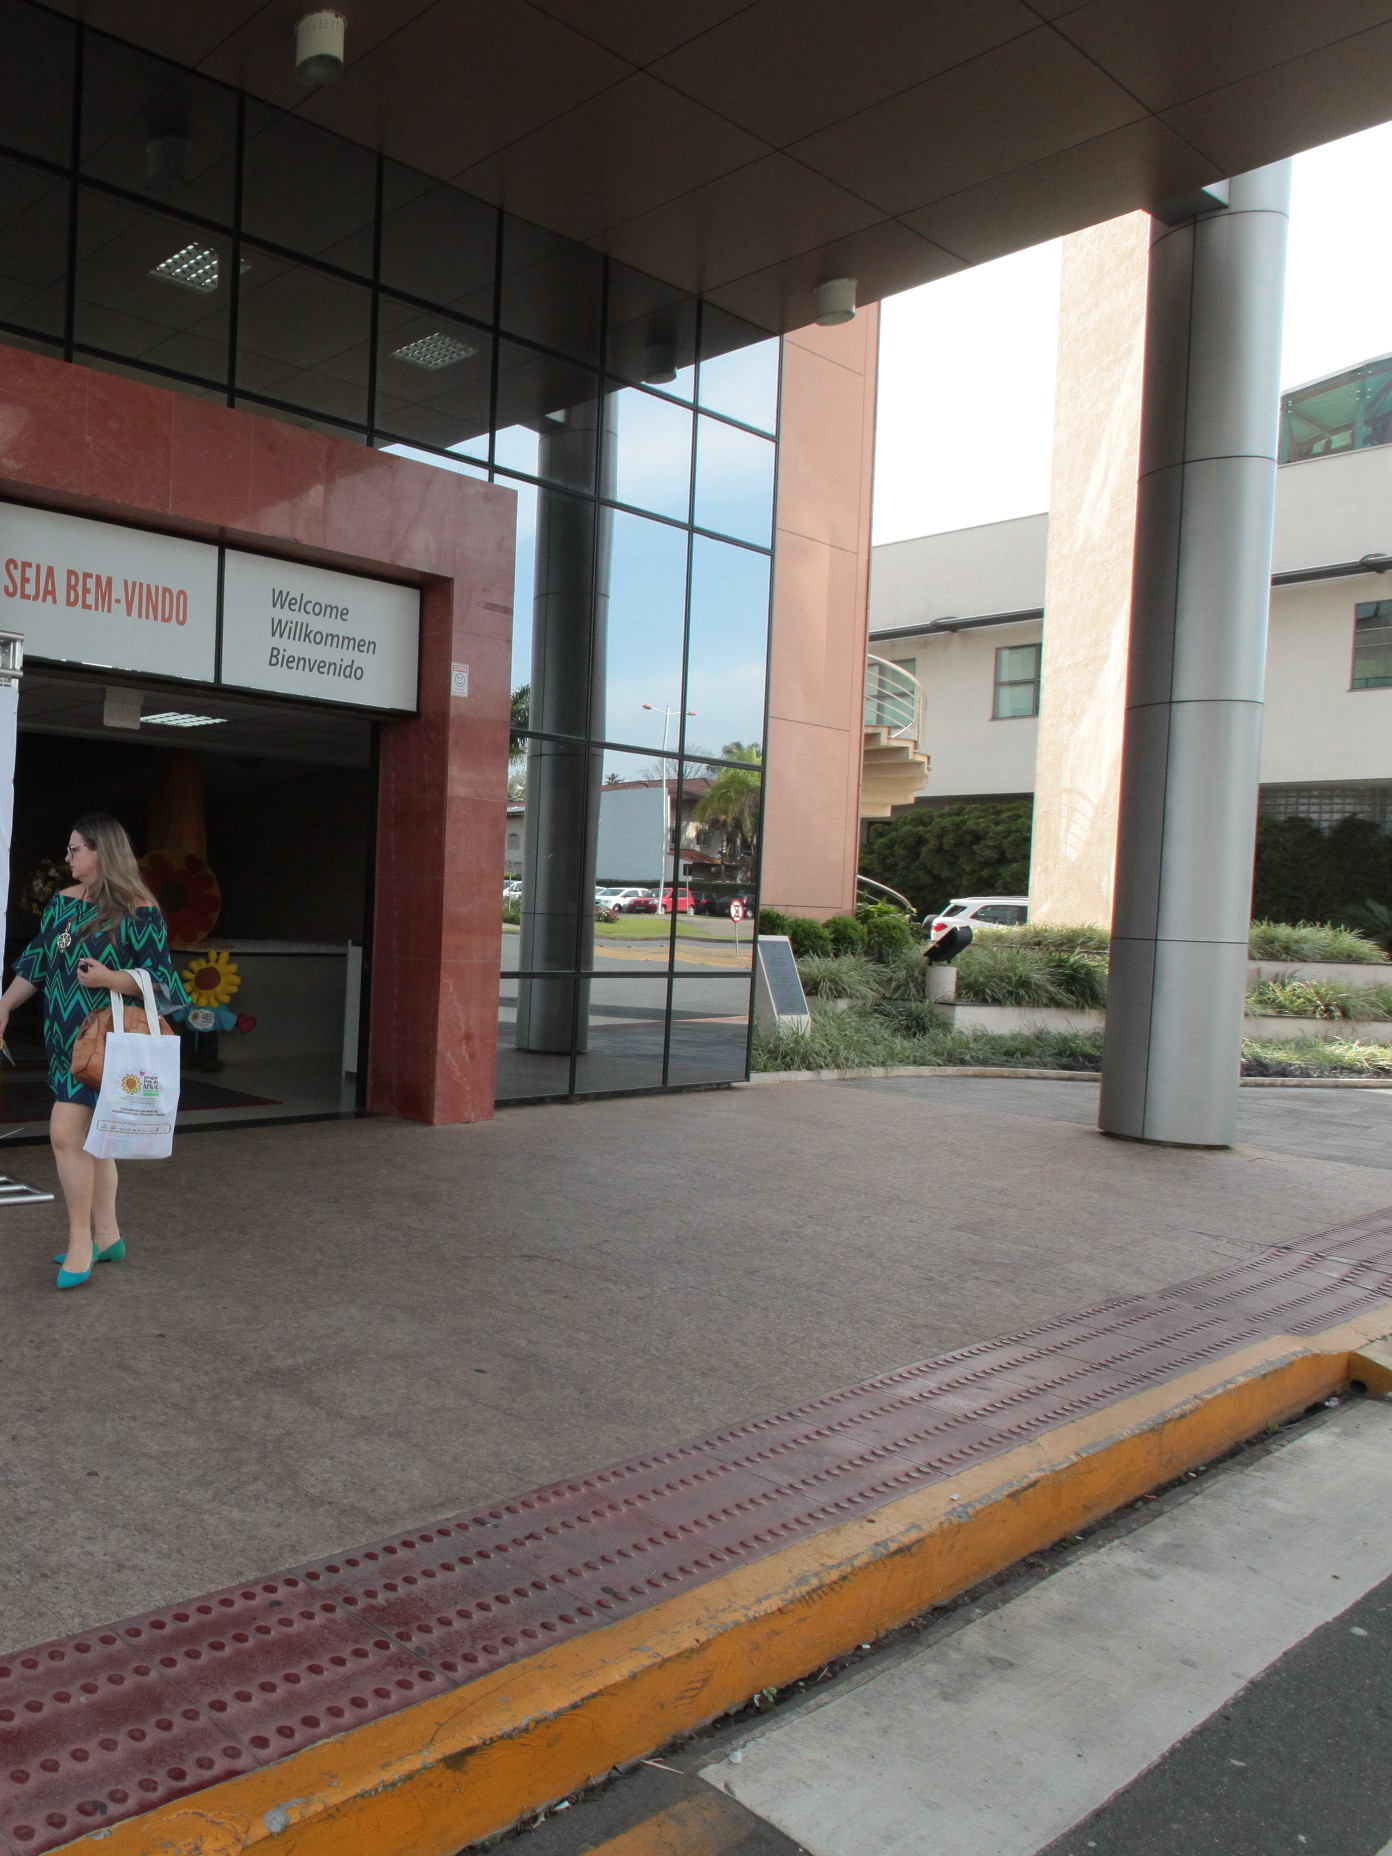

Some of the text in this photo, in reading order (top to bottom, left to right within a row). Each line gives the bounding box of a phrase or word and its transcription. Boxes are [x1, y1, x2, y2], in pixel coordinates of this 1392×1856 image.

[3, 558, 188, 627] SEJA BEM-VINDO
[271, 588, 349, 622] Welcome
[270, 617, 377, 655] Willkommen
[268, 647, 364, 681] Bienvenido
